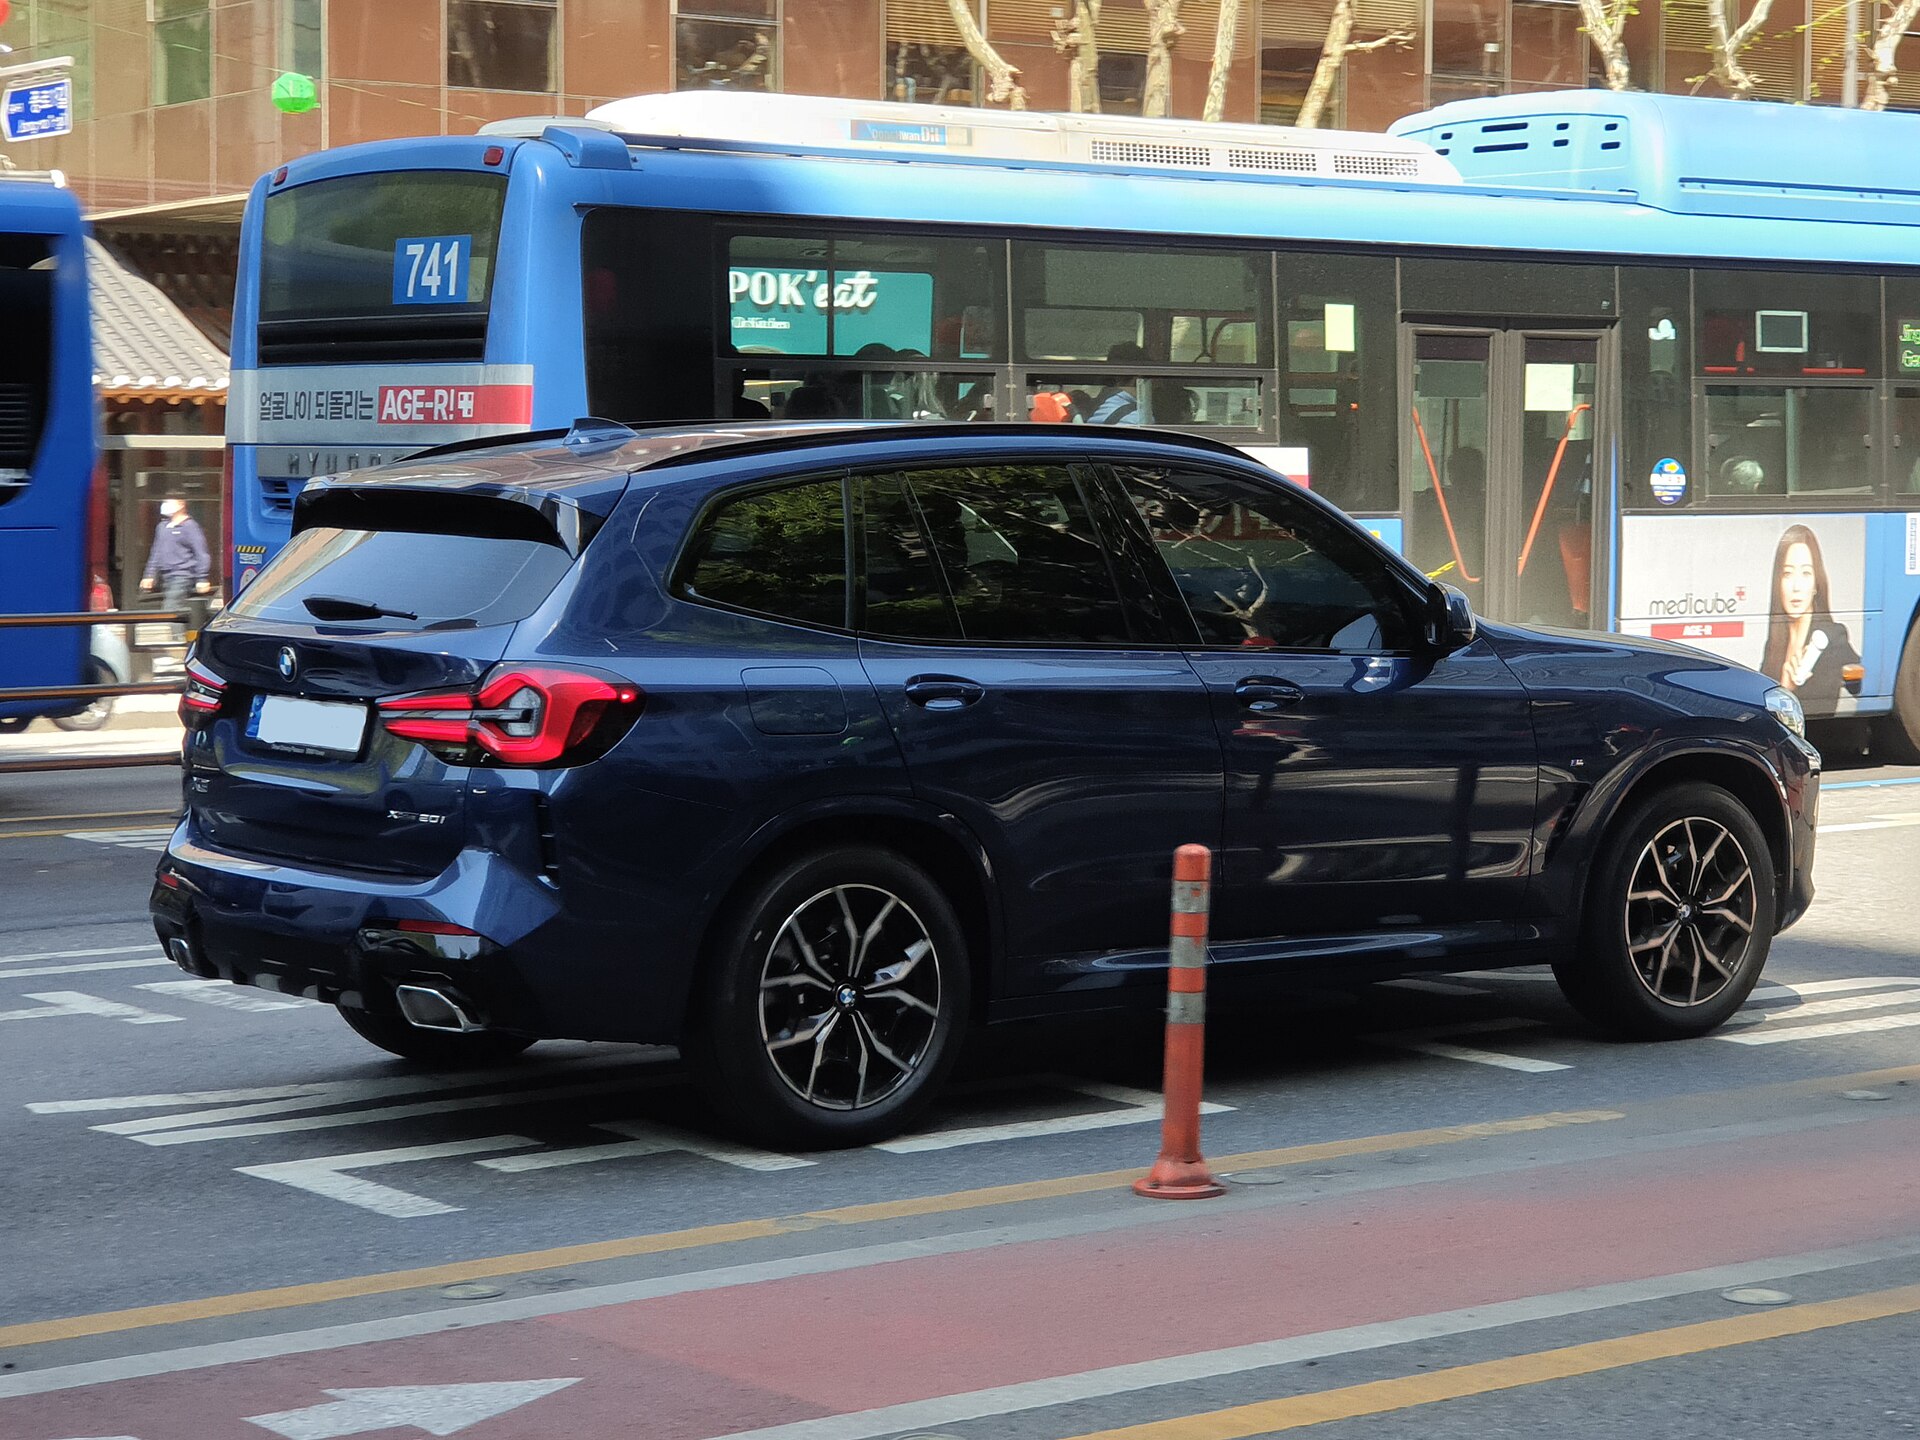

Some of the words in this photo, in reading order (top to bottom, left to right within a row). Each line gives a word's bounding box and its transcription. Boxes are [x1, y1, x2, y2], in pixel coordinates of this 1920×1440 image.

[406, 241, 459, 298] 741
[259, 390, 311, 421] 얼굴나이
[314, 389, 374, 420] 되돌리는
[381, 388, 455, 421] AGE-R!
[1648, 592, 1737, 615] medicube
